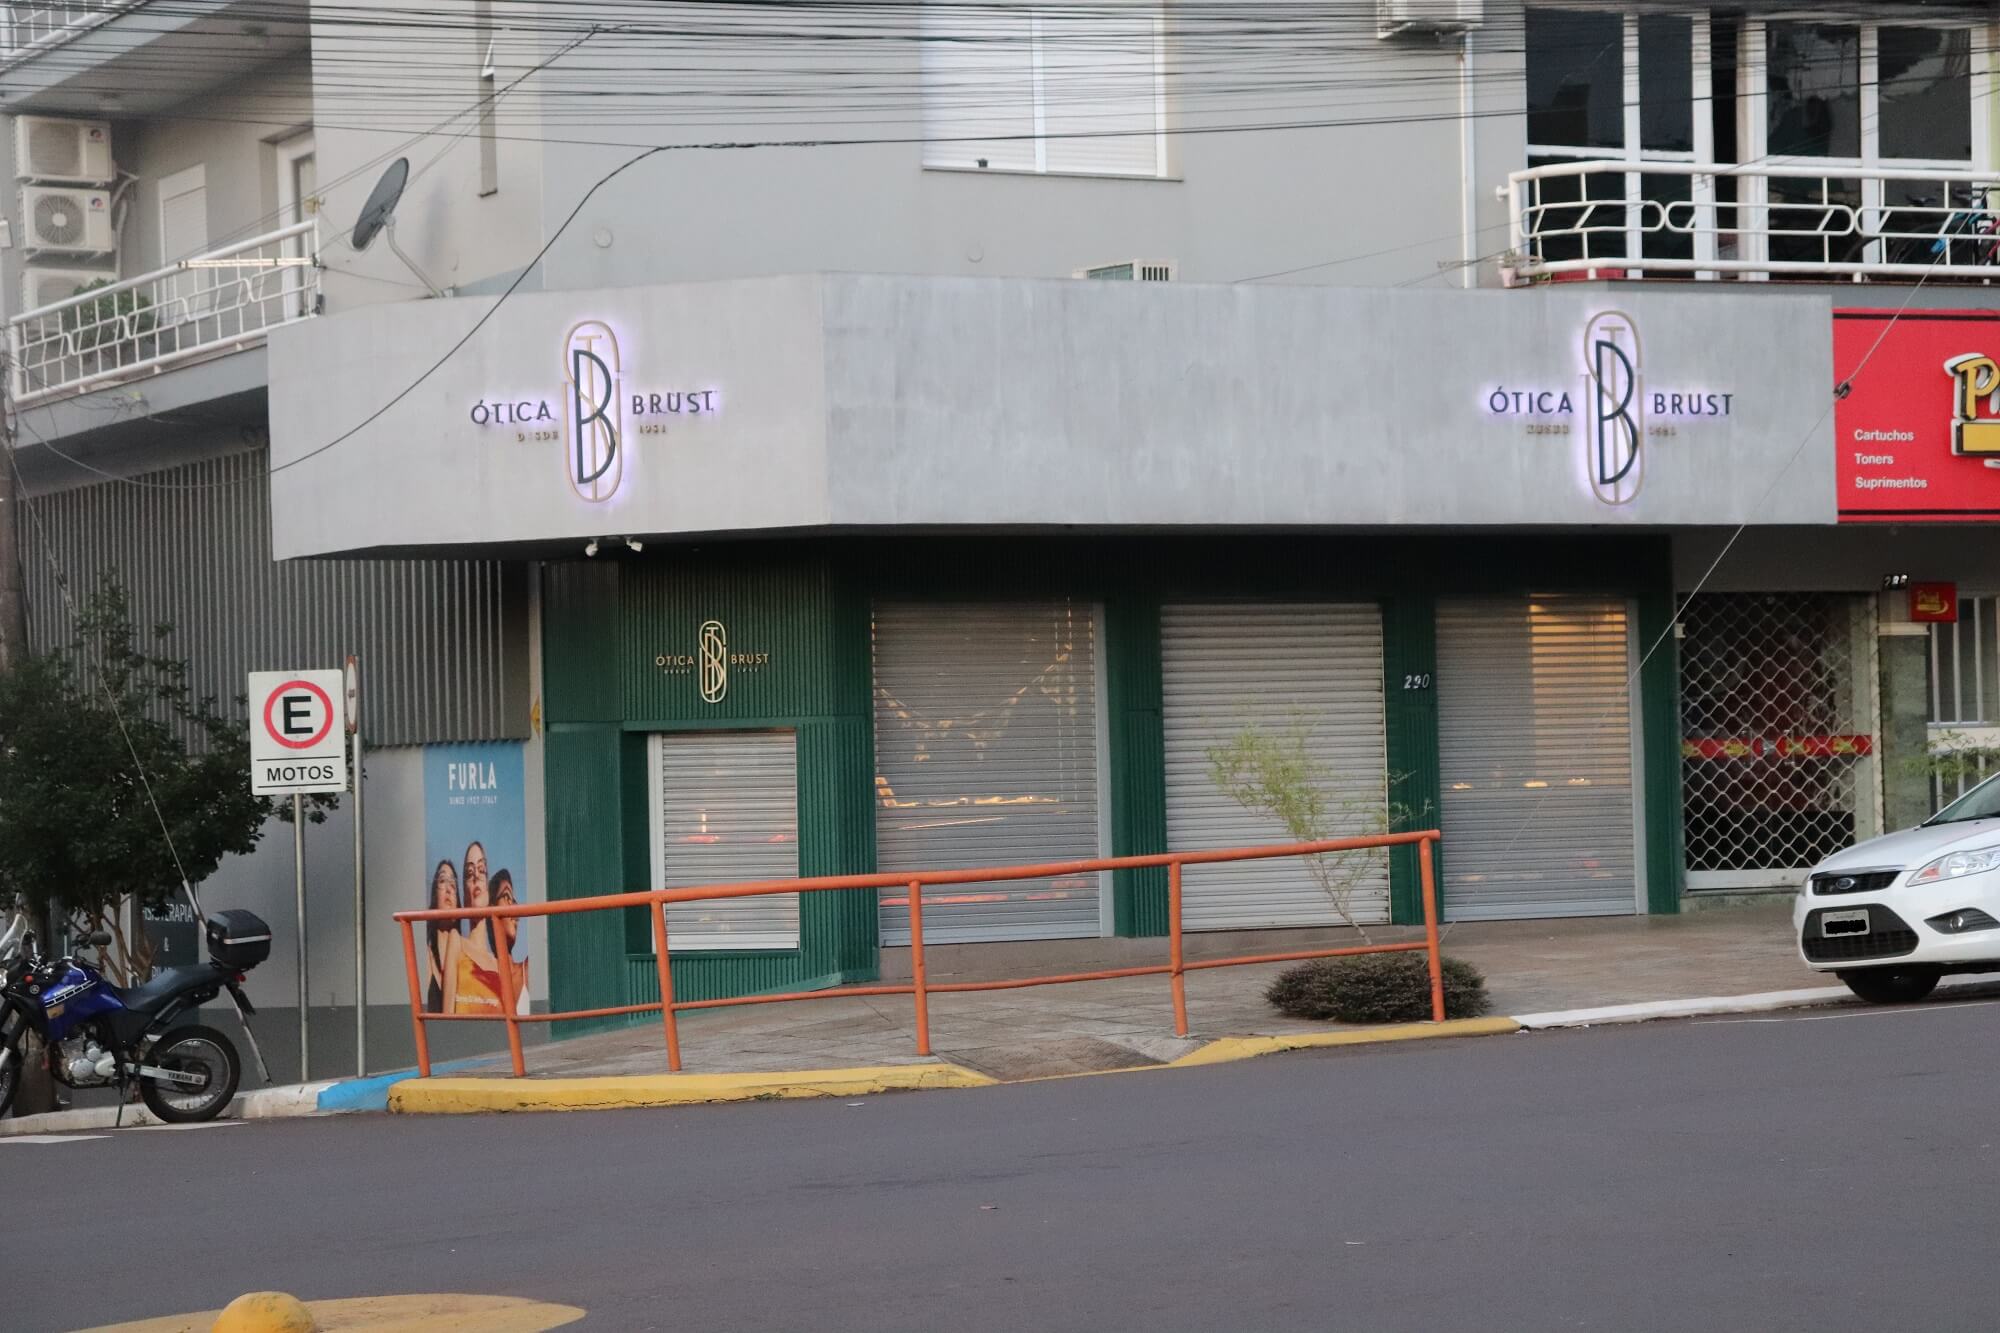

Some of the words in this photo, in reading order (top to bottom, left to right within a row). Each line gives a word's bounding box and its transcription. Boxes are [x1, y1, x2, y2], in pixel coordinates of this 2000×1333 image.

[470, 399, 552, 425] ÓTICA
[632, 390, 715, 415] BRUST
[1489, 386, 1574, 414] ÓTICA
[1654, 393, 1734, 416] BRUST
[1854, 429, 1914, 441] Cartuchos
[1854, 452, 1894, 465] Toners
[1855, 476, 1928, 490] Suprimentos
[731, 653, 769, 665] BRUST
[1403, 673, 1430, 689] 290
[282, 695, 313, 734] E
[267, 765, 334, 782] MOTOS
[448, 762, 497, 790] FURLA
